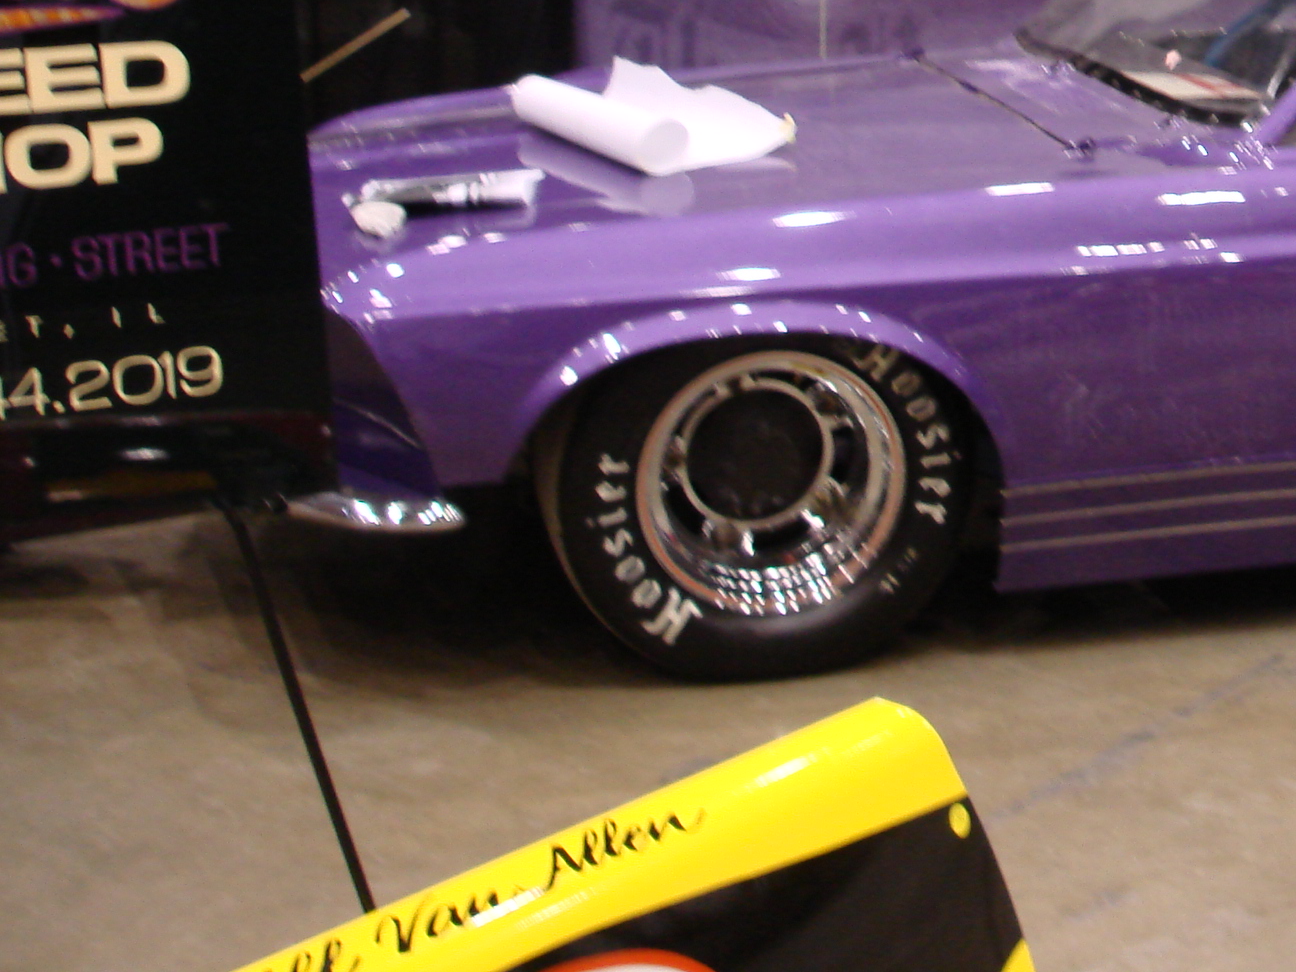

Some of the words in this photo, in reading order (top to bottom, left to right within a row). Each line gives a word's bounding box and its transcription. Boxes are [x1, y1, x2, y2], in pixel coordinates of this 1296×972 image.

[0, 116, 164, 194] OP
[71, 222, 229, 281] STREET
[0, 344, 223, 421] 4.2019
